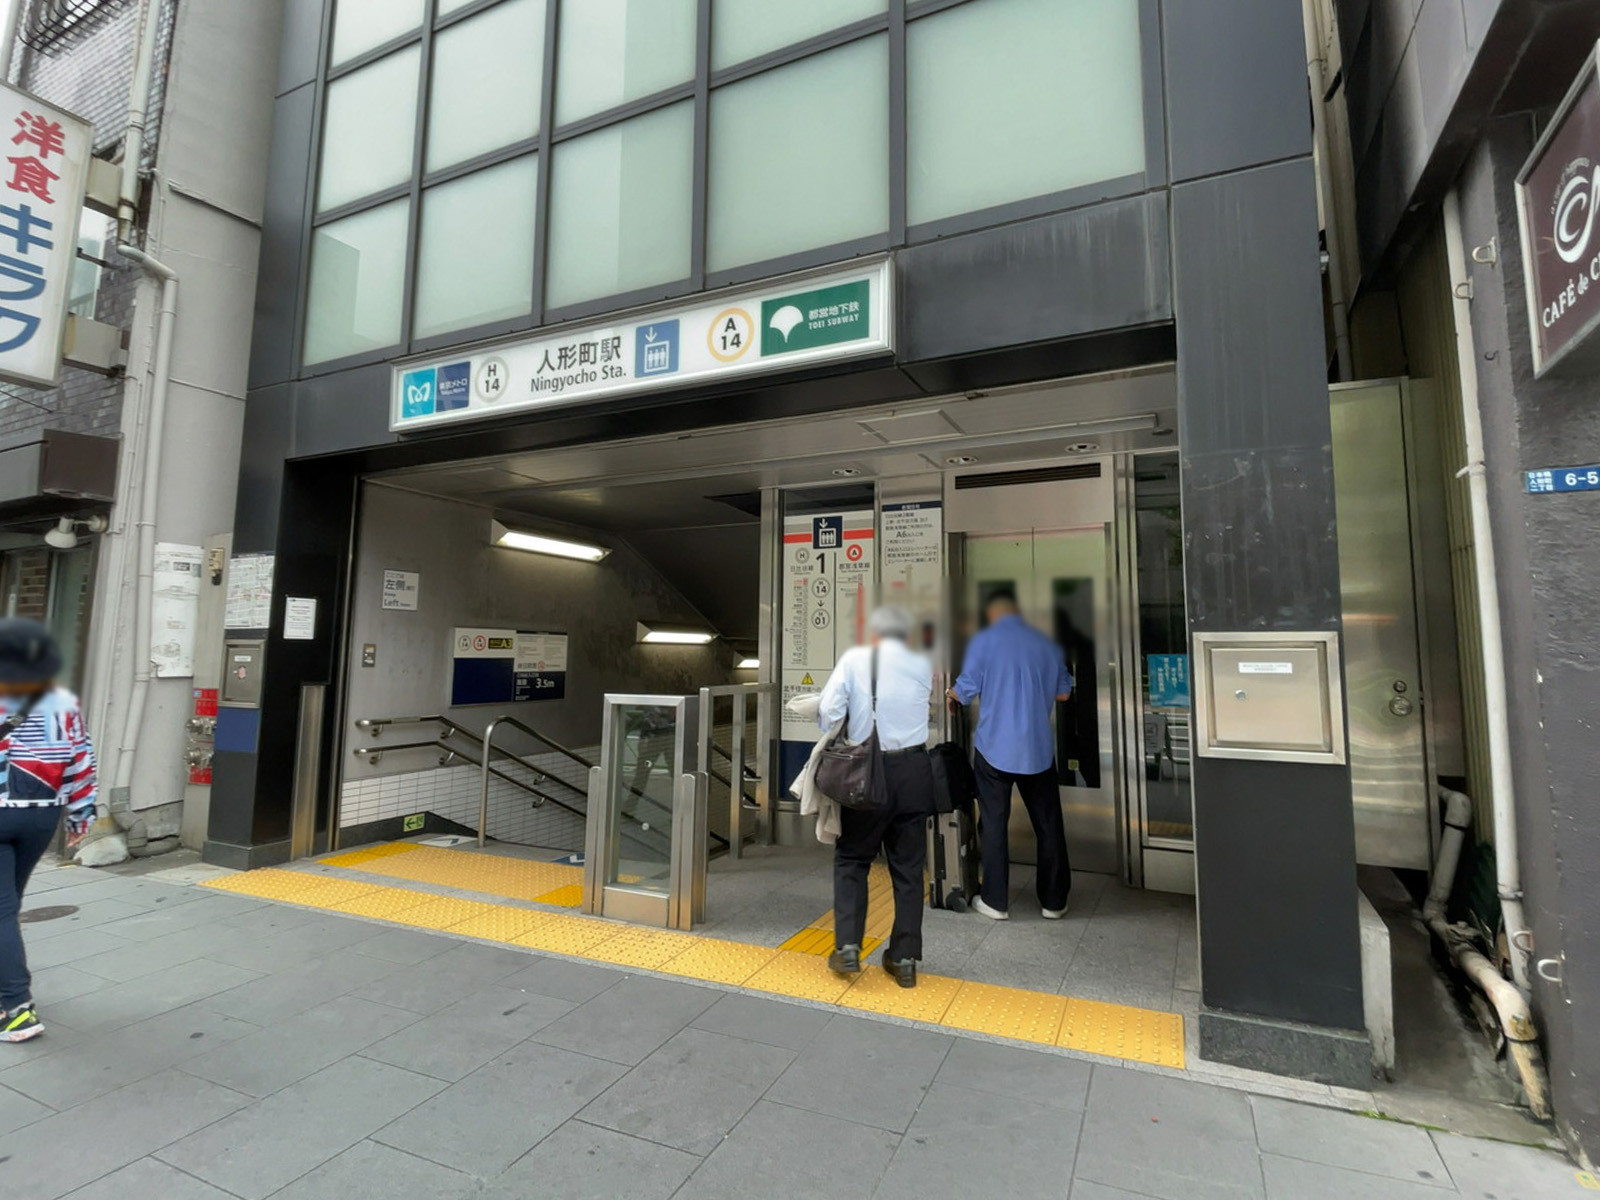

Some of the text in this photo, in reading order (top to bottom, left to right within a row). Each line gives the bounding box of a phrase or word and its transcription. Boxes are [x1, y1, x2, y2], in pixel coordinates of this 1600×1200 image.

[5, 110, 65, 204] 洋食
[1542, 278, 1576, 328] CAFÉ
[1577, 272, 1589, 295] de
[808, 301, 860, 320] 都営地下鉄
[724, 317, 737, 332] A
[808, 313, 860, 330] TOEI SUBWAY
[721, 333, 742, 350] 14
[536, 336, 621, 374] 人形町駅
[487, 364, 497, 378] H
[530, 364, 627, 393] Ningyocho Sta.
[484, 379, 500, 393] 14
[1565, 471, 1599, 486] 6-5
[816, 552, 825, 574] 1
[816, 585, 827, 594] 14
[814, 616, 826, 625] 01
